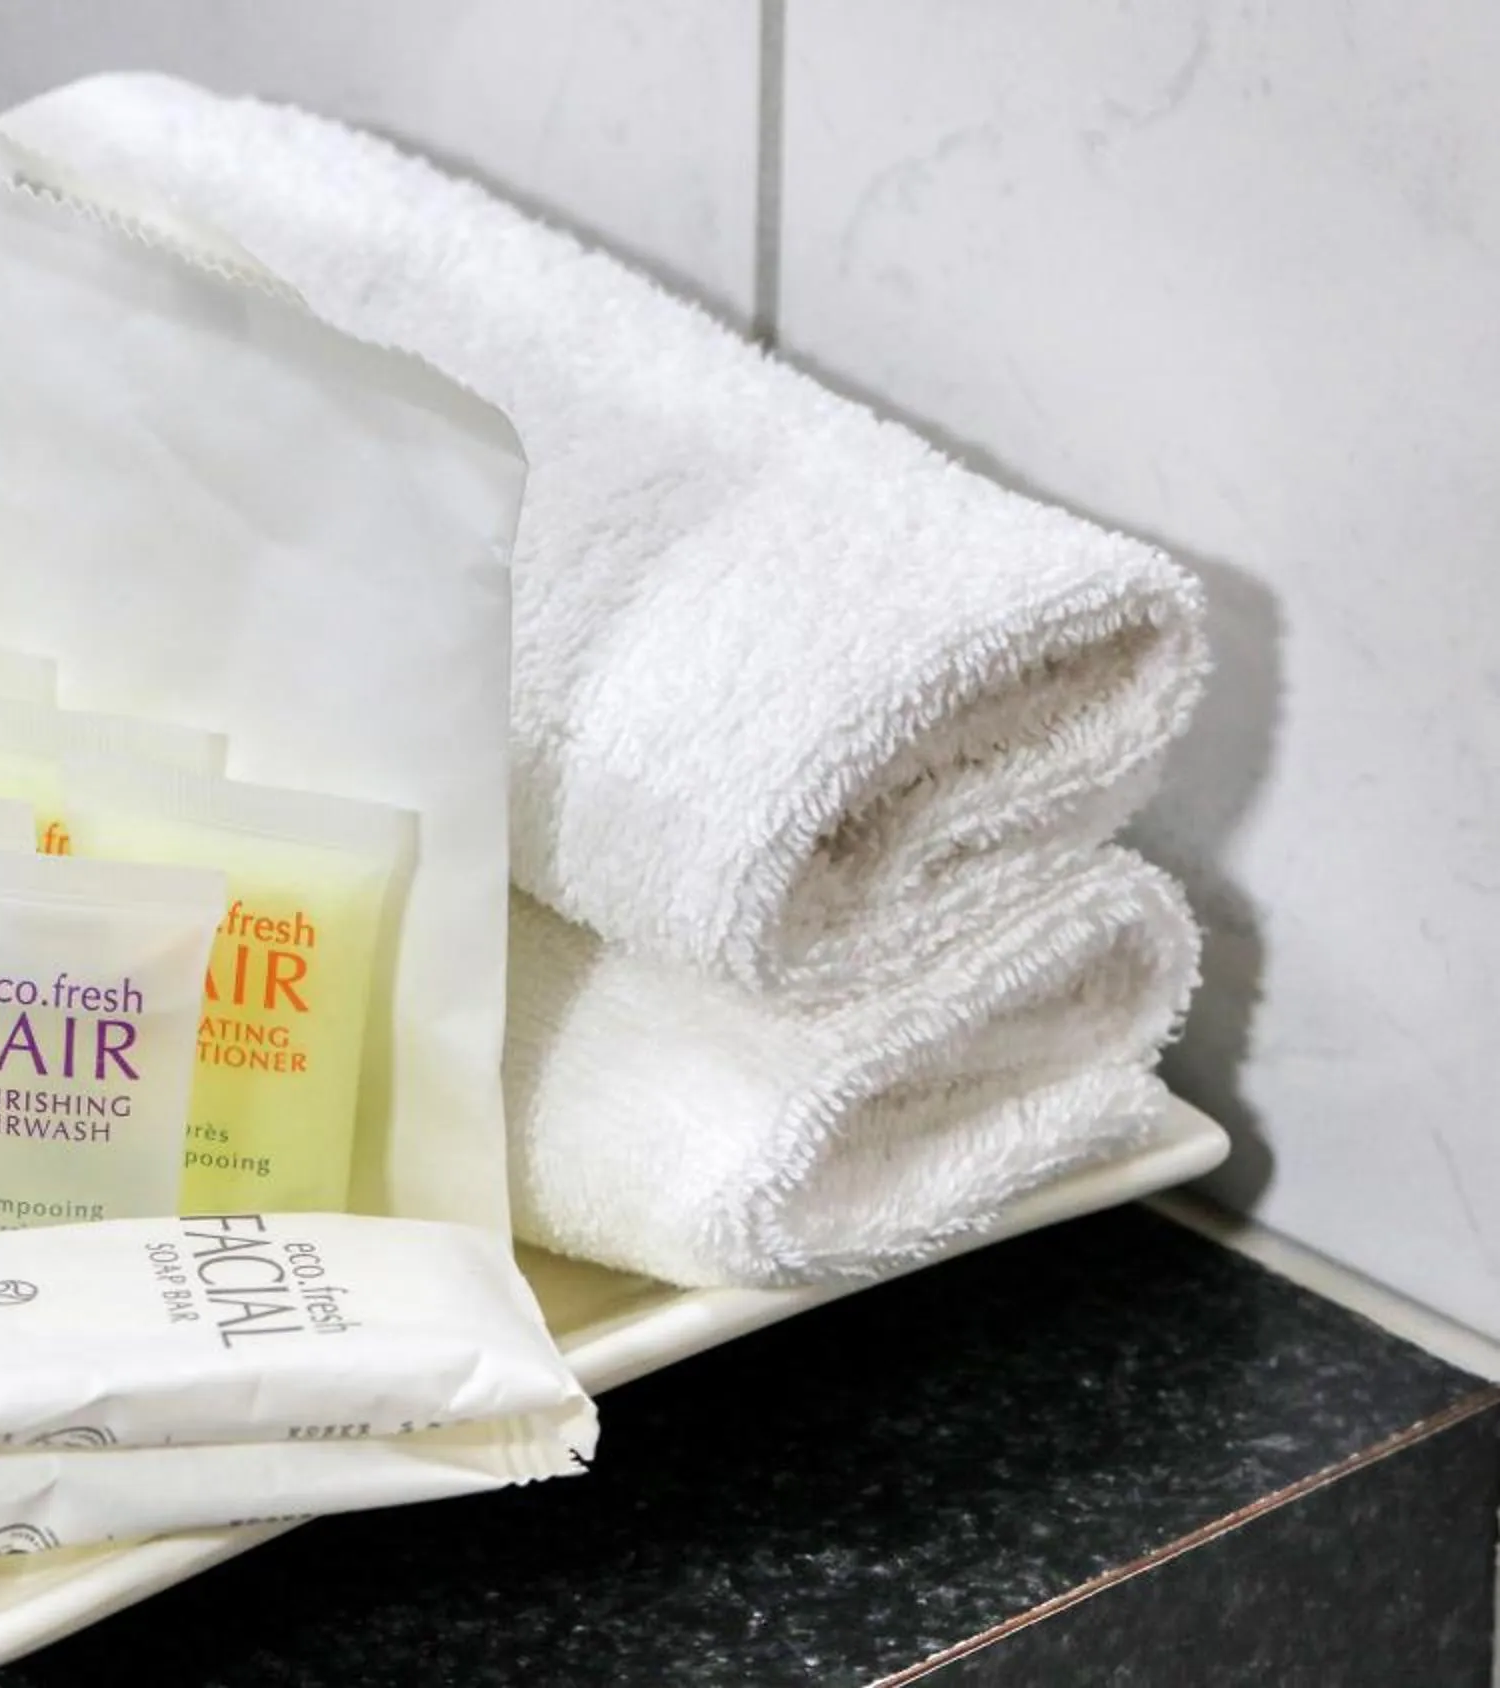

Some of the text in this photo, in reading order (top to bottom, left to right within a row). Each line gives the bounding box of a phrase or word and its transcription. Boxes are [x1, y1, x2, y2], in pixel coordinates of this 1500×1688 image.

[145, 1243, 201, 1324] SOAP BAR
[179, 1213, 305, 1349] FACIAL
[283, 1242, 362, 1336] eco.fresh
